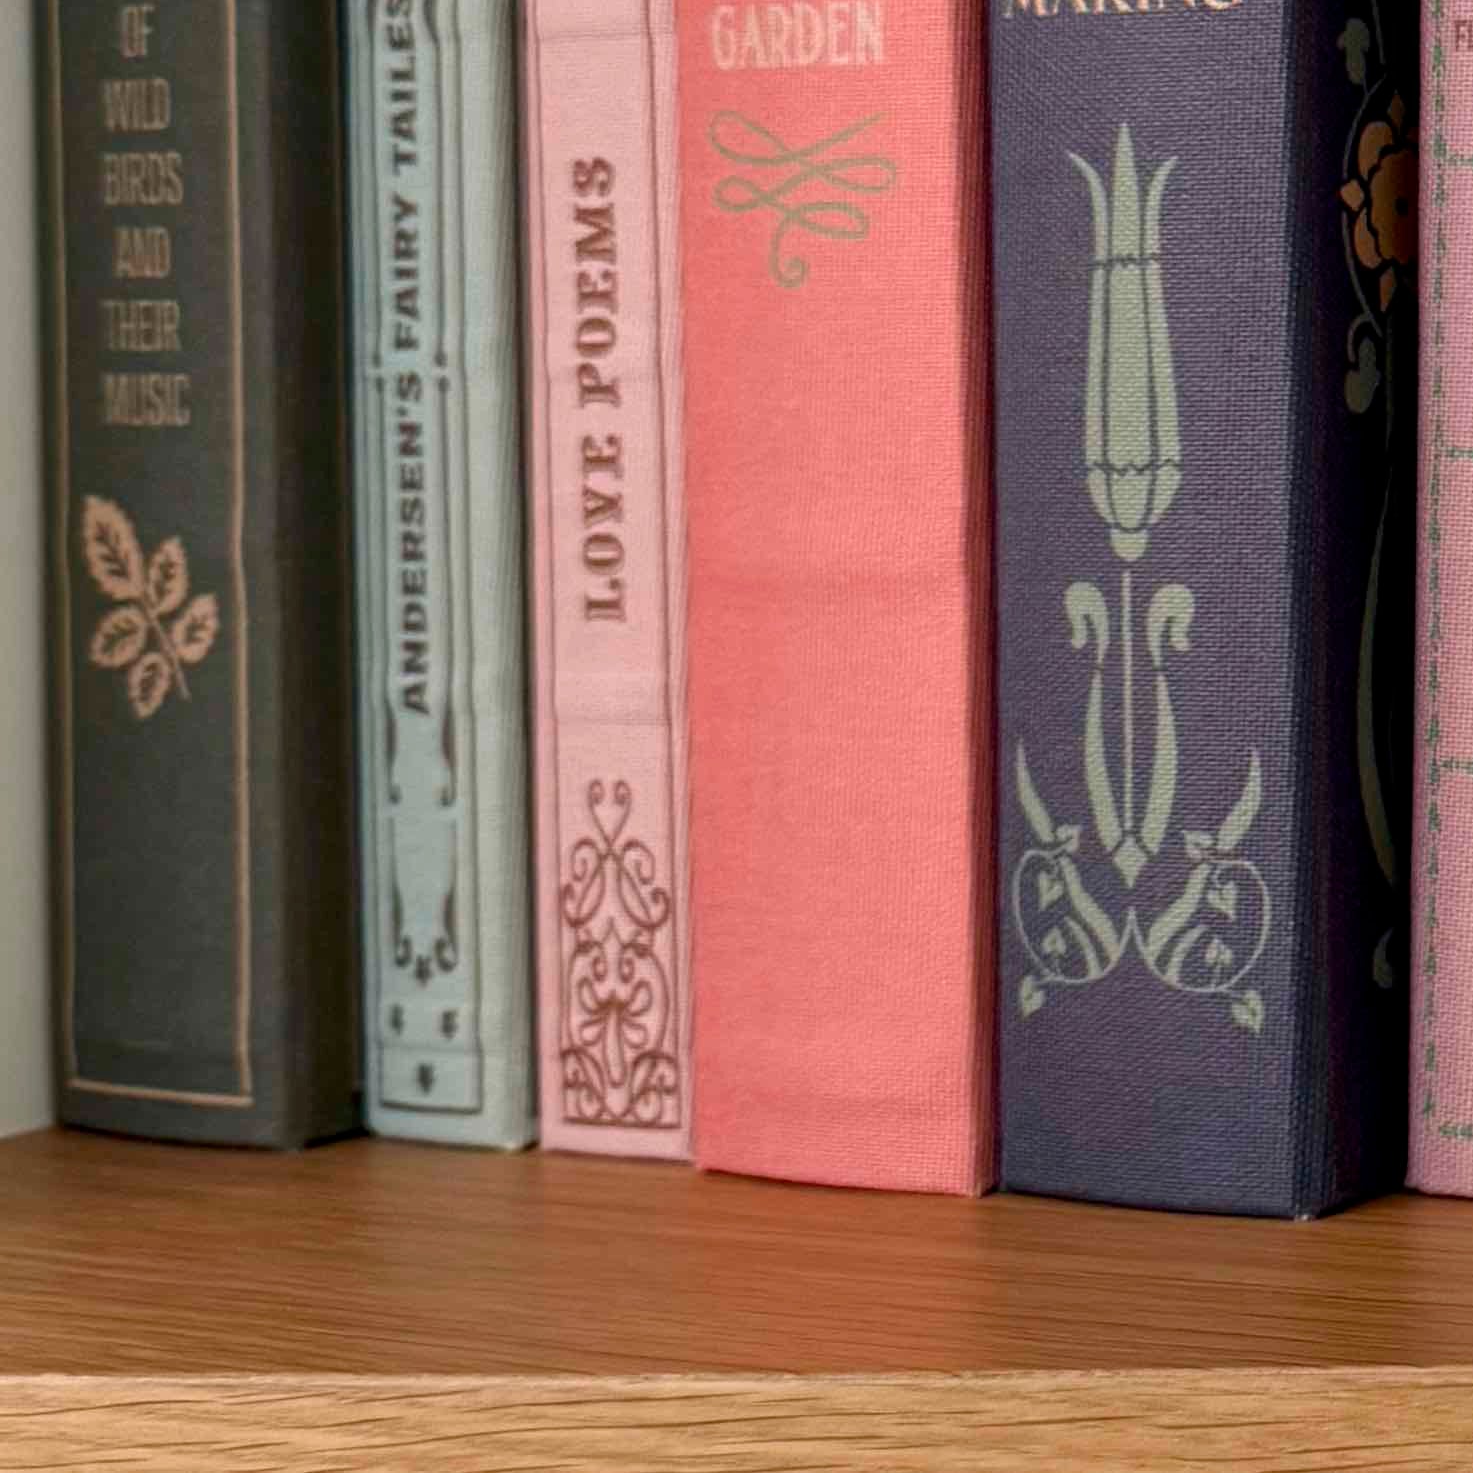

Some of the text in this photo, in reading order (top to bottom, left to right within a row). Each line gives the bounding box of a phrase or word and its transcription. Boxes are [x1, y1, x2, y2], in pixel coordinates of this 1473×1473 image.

[121, 4, 156, 57] OF
[713, 0, 884, 71] GARDEN
[103, 77, 171, 131] WILD
[104, 152, 184, 205] BIRDS
[115, 226, 171, 278] AND
[391, 192, 421, 351] FAIRY
[103, 299, 182, 351] THEIR
[104, 372, 191, 426] MUSIC
[574, 157, 626, 623] LOVE POEMS
[397, 370, 430, 715] ANDERSEN'S
